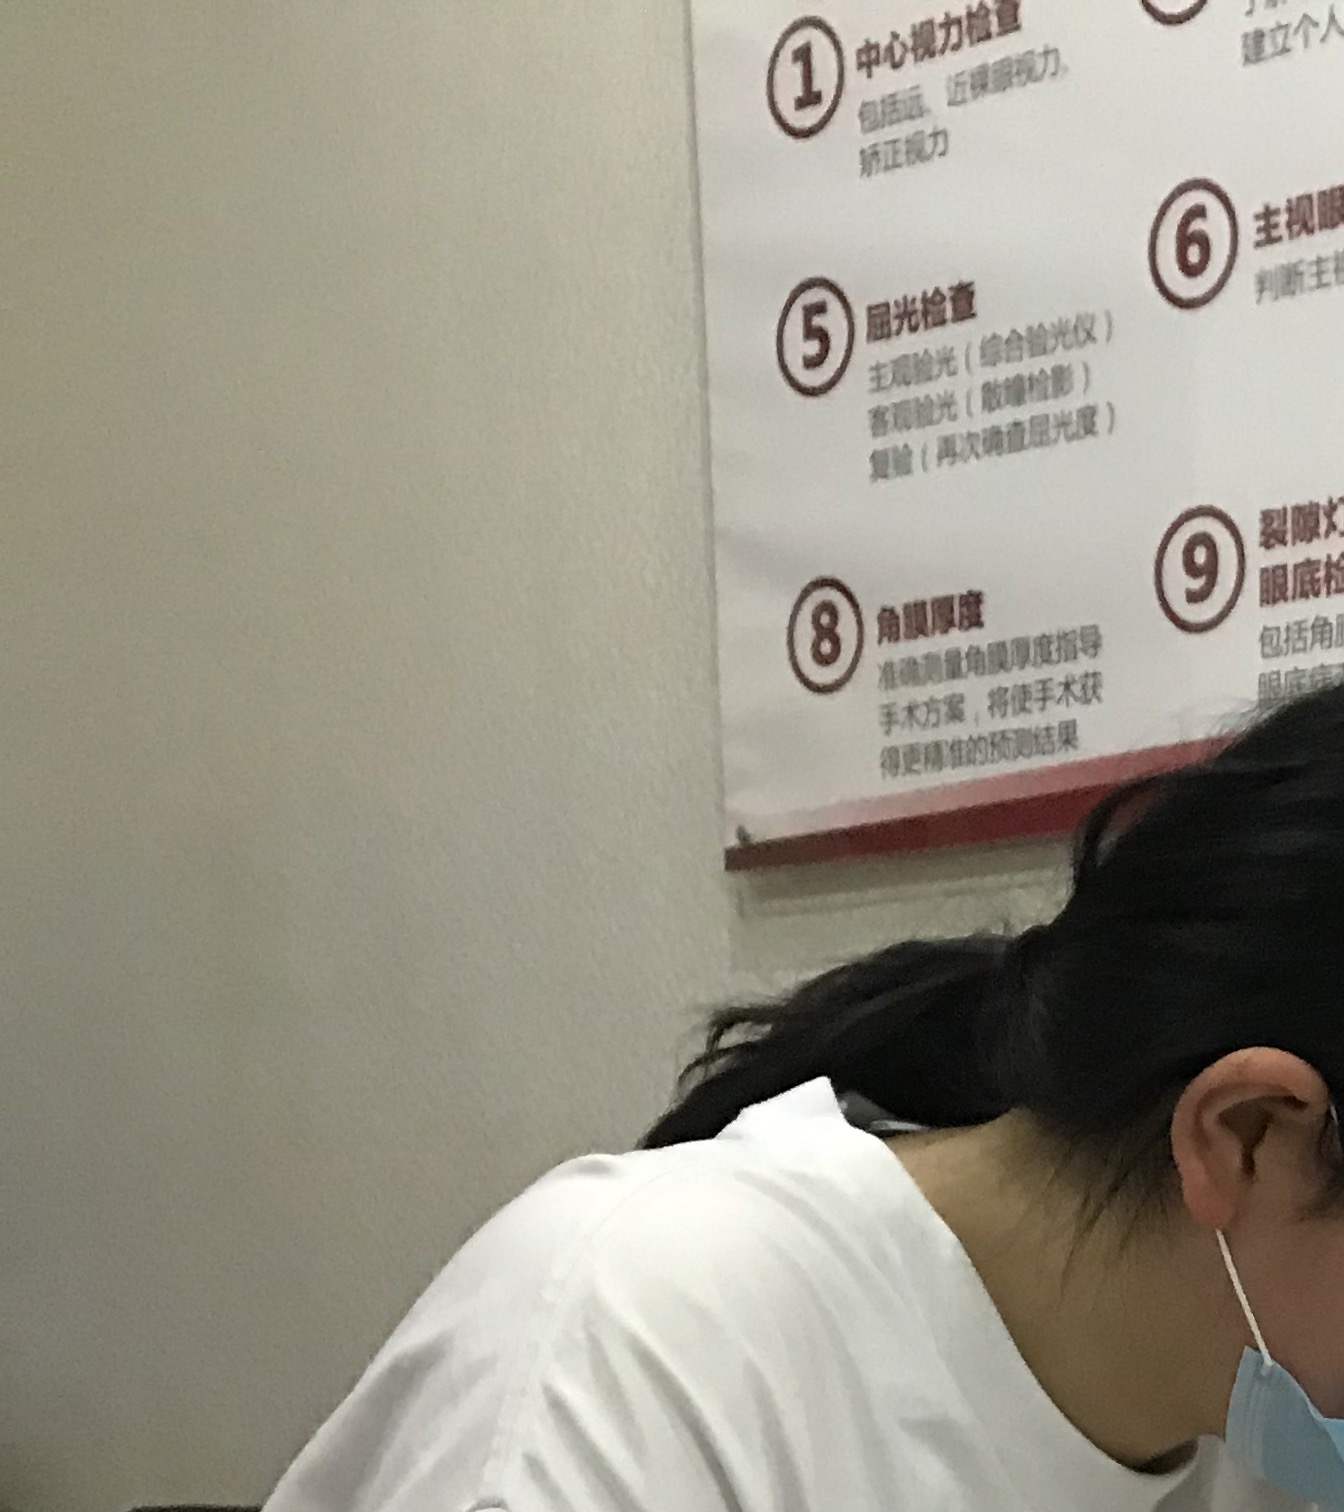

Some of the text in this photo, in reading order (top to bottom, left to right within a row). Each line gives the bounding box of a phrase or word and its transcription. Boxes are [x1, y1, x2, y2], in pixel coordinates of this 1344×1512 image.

[856, 0, 1021, 78] 中心视力检查
[793, 41, 823, 111] 1
[858, 127, 949, 178] 矫正视力
[1175, 203, 1211, 278] 6
[802, 300, 831, 370] 5
[866, 279, 977, 344] 屈光检查
[1181, 531, 1219, 604] 9
[811, 600, 841, 666] 8
[877, 588, 984, 646] 角膜厚度
